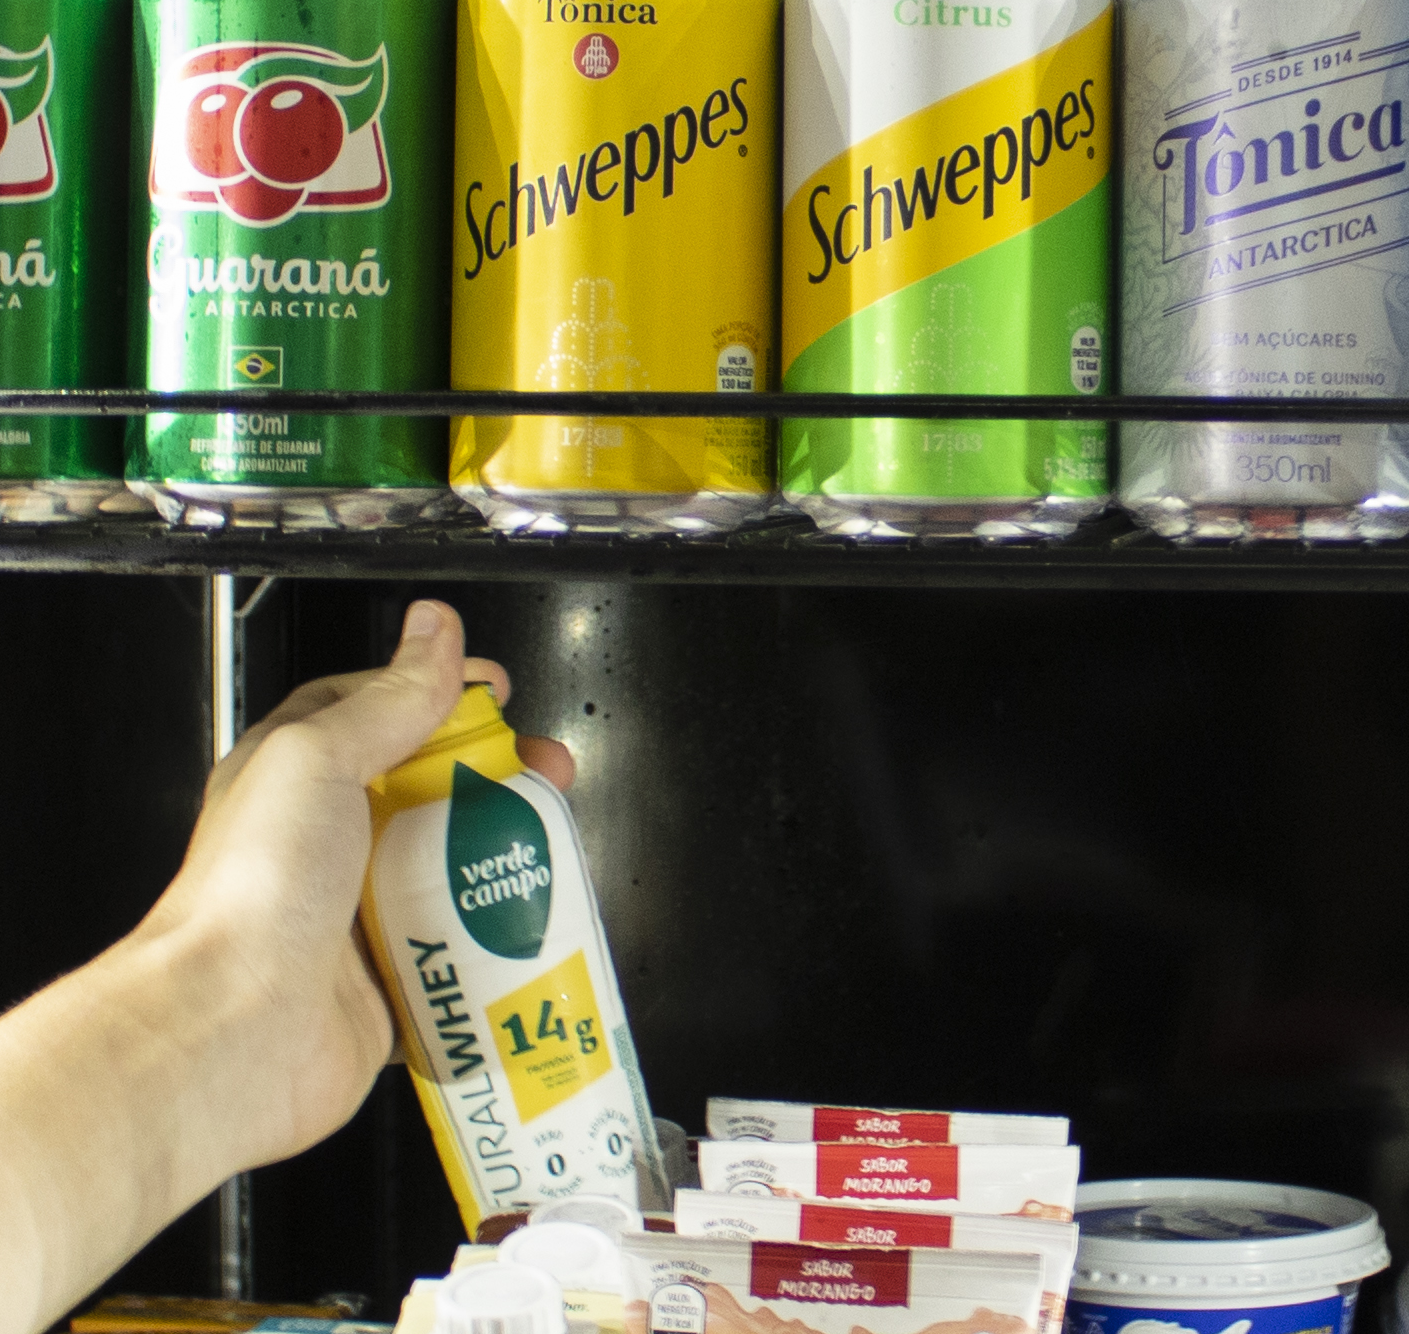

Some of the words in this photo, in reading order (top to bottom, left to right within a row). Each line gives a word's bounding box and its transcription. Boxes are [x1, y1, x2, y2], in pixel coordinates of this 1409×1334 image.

[1239, 60, 1305, 93] DESDE
[1313, 48, 1353, 74] 1914
[464, 77, 749, 281] Schweppes
[1153, 98, 1406, 237] Tônica
[808, 79, 1095, 285] Schweppes
[1208, 214, 1378, 281] ANTARCTICA
[147, 223, 390, 321] Guaraná
[205, 299, 358, 319] ANTARCTICA
[1255, 329, 1358, 350] AÇÚCARES
[1294, 371, 1316, 385] DE
[459, 841, 538, 886] verde
[459, 865, 551, 912] campo
[854, 1117, 901, 1134] SABOR
[859, 1156, 909, 1174] SABOR
[842, 1177, 932, 1194] MORANGO
[845, 1226, 898, 1245] SABOR
[800, 1259, 854, 1279] SABOR
[777, 1279, 877, 1302] MORANGO
